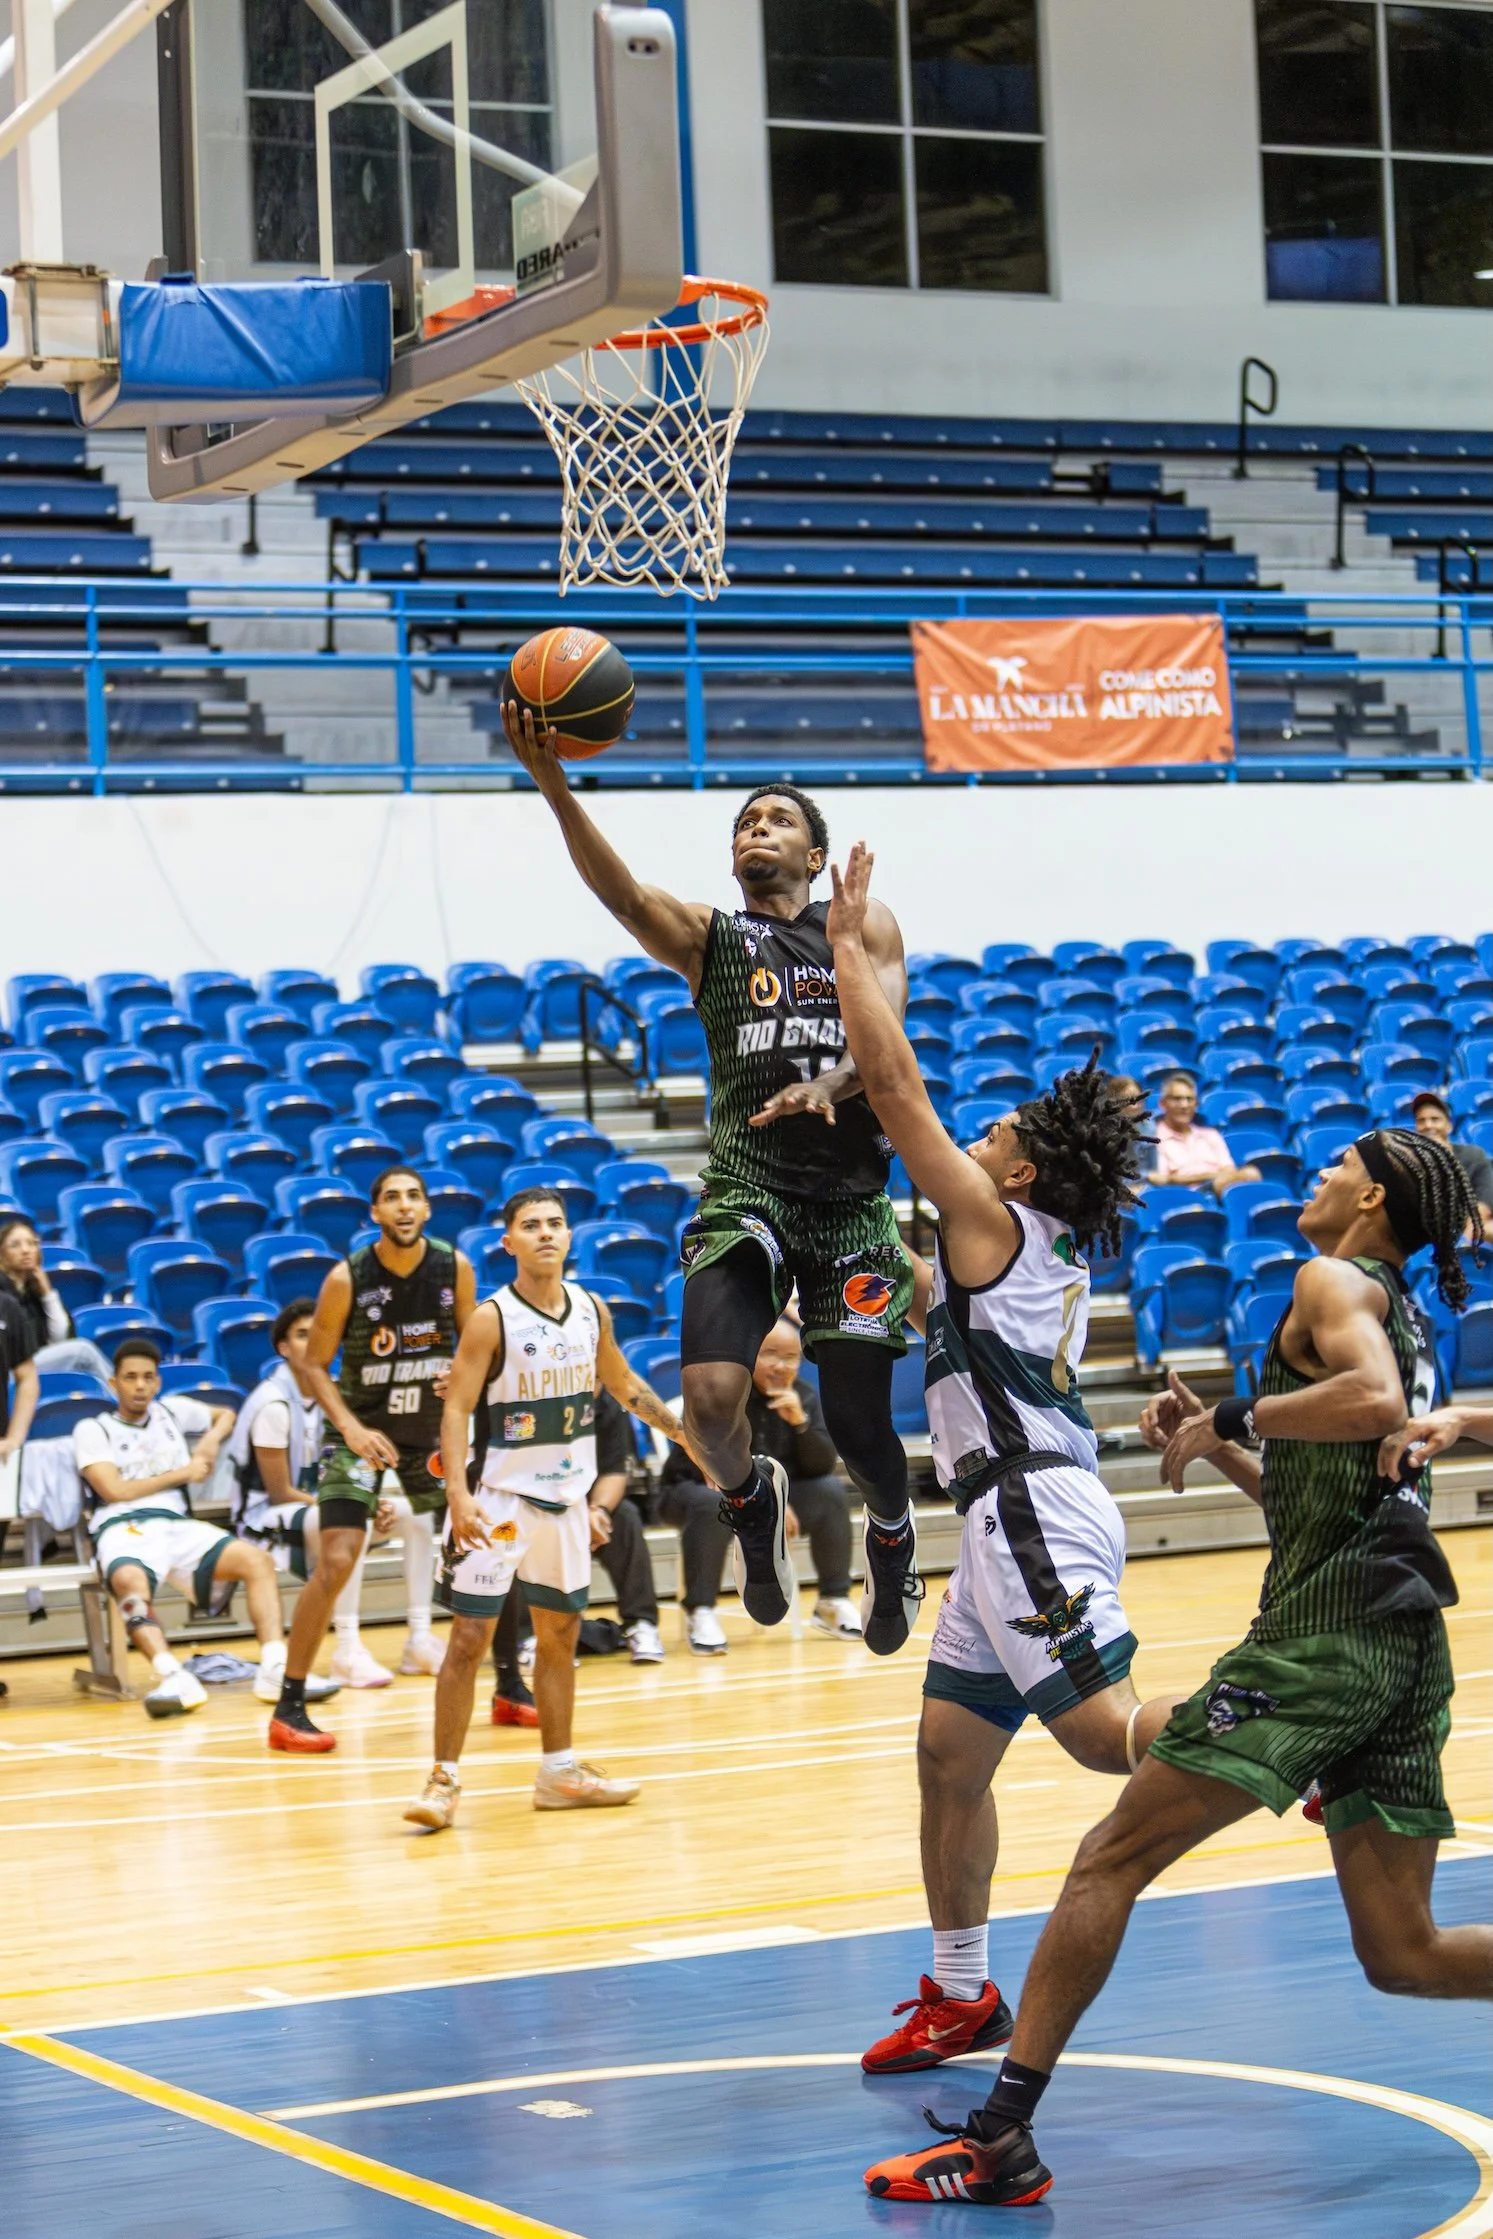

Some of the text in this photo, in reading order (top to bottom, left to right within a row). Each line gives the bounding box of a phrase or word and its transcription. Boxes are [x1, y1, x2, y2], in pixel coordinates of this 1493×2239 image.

[1099, 669, 1154, 691] COME
[1153, 666, 1217, 689] COMO
[929, 694, 969, 720] LA
[1099, 690, 1223, 720] ALPINISTA
[793, 964, 837, 985] HOM
[794, 980, 838, 999] POW
[797, 997, 838, 1007] SUN ENER
[736, 1016, 846, 1058] RIO GRAN
[387, 1386, 421, 1415] 50
[563, 1406, 574, 1436] 2
